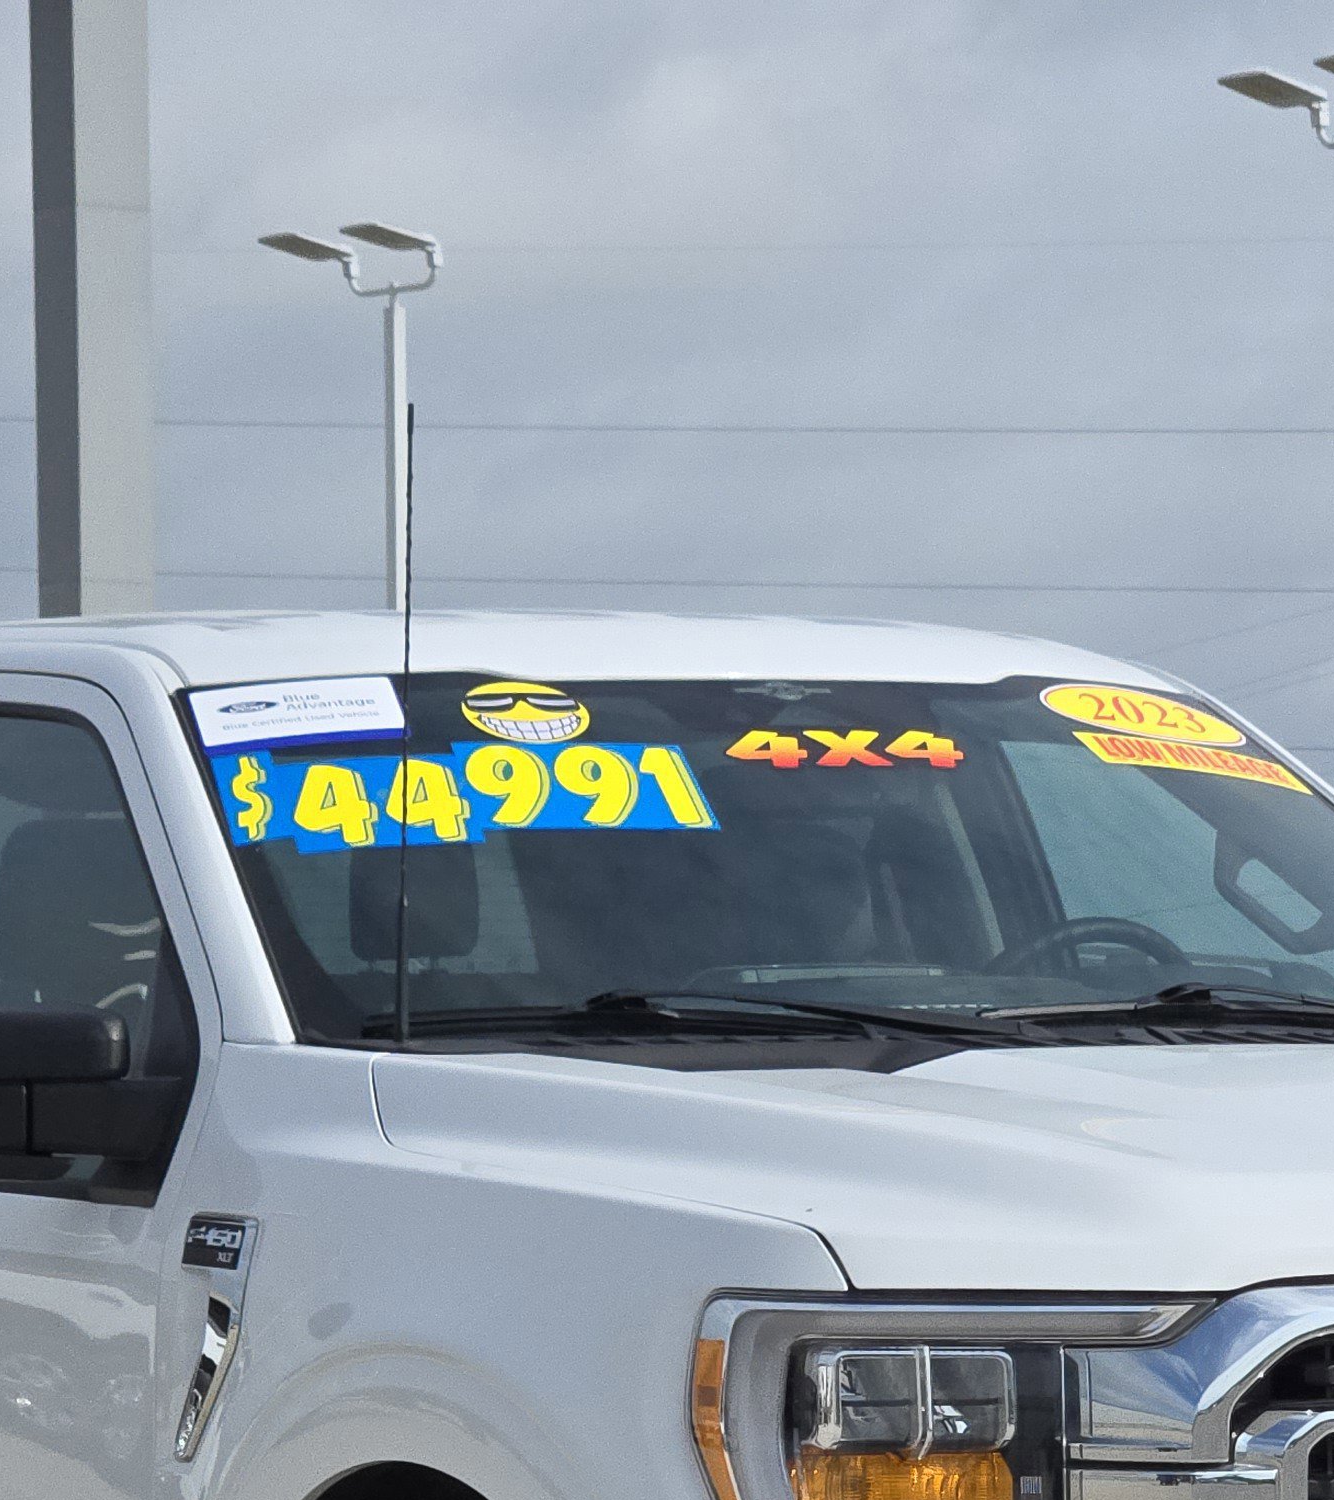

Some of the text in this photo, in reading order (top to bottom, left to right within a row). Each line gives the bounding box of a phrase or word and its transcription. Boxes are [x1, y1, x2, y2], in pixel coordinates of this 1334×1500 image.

[282, 694, 320, 702] Blue
[285, 697, 376, 712] Advantage
[1078, 693, 1206, 733] 2023
[1092, 736, 1292, 786] LOW MILEAGE
